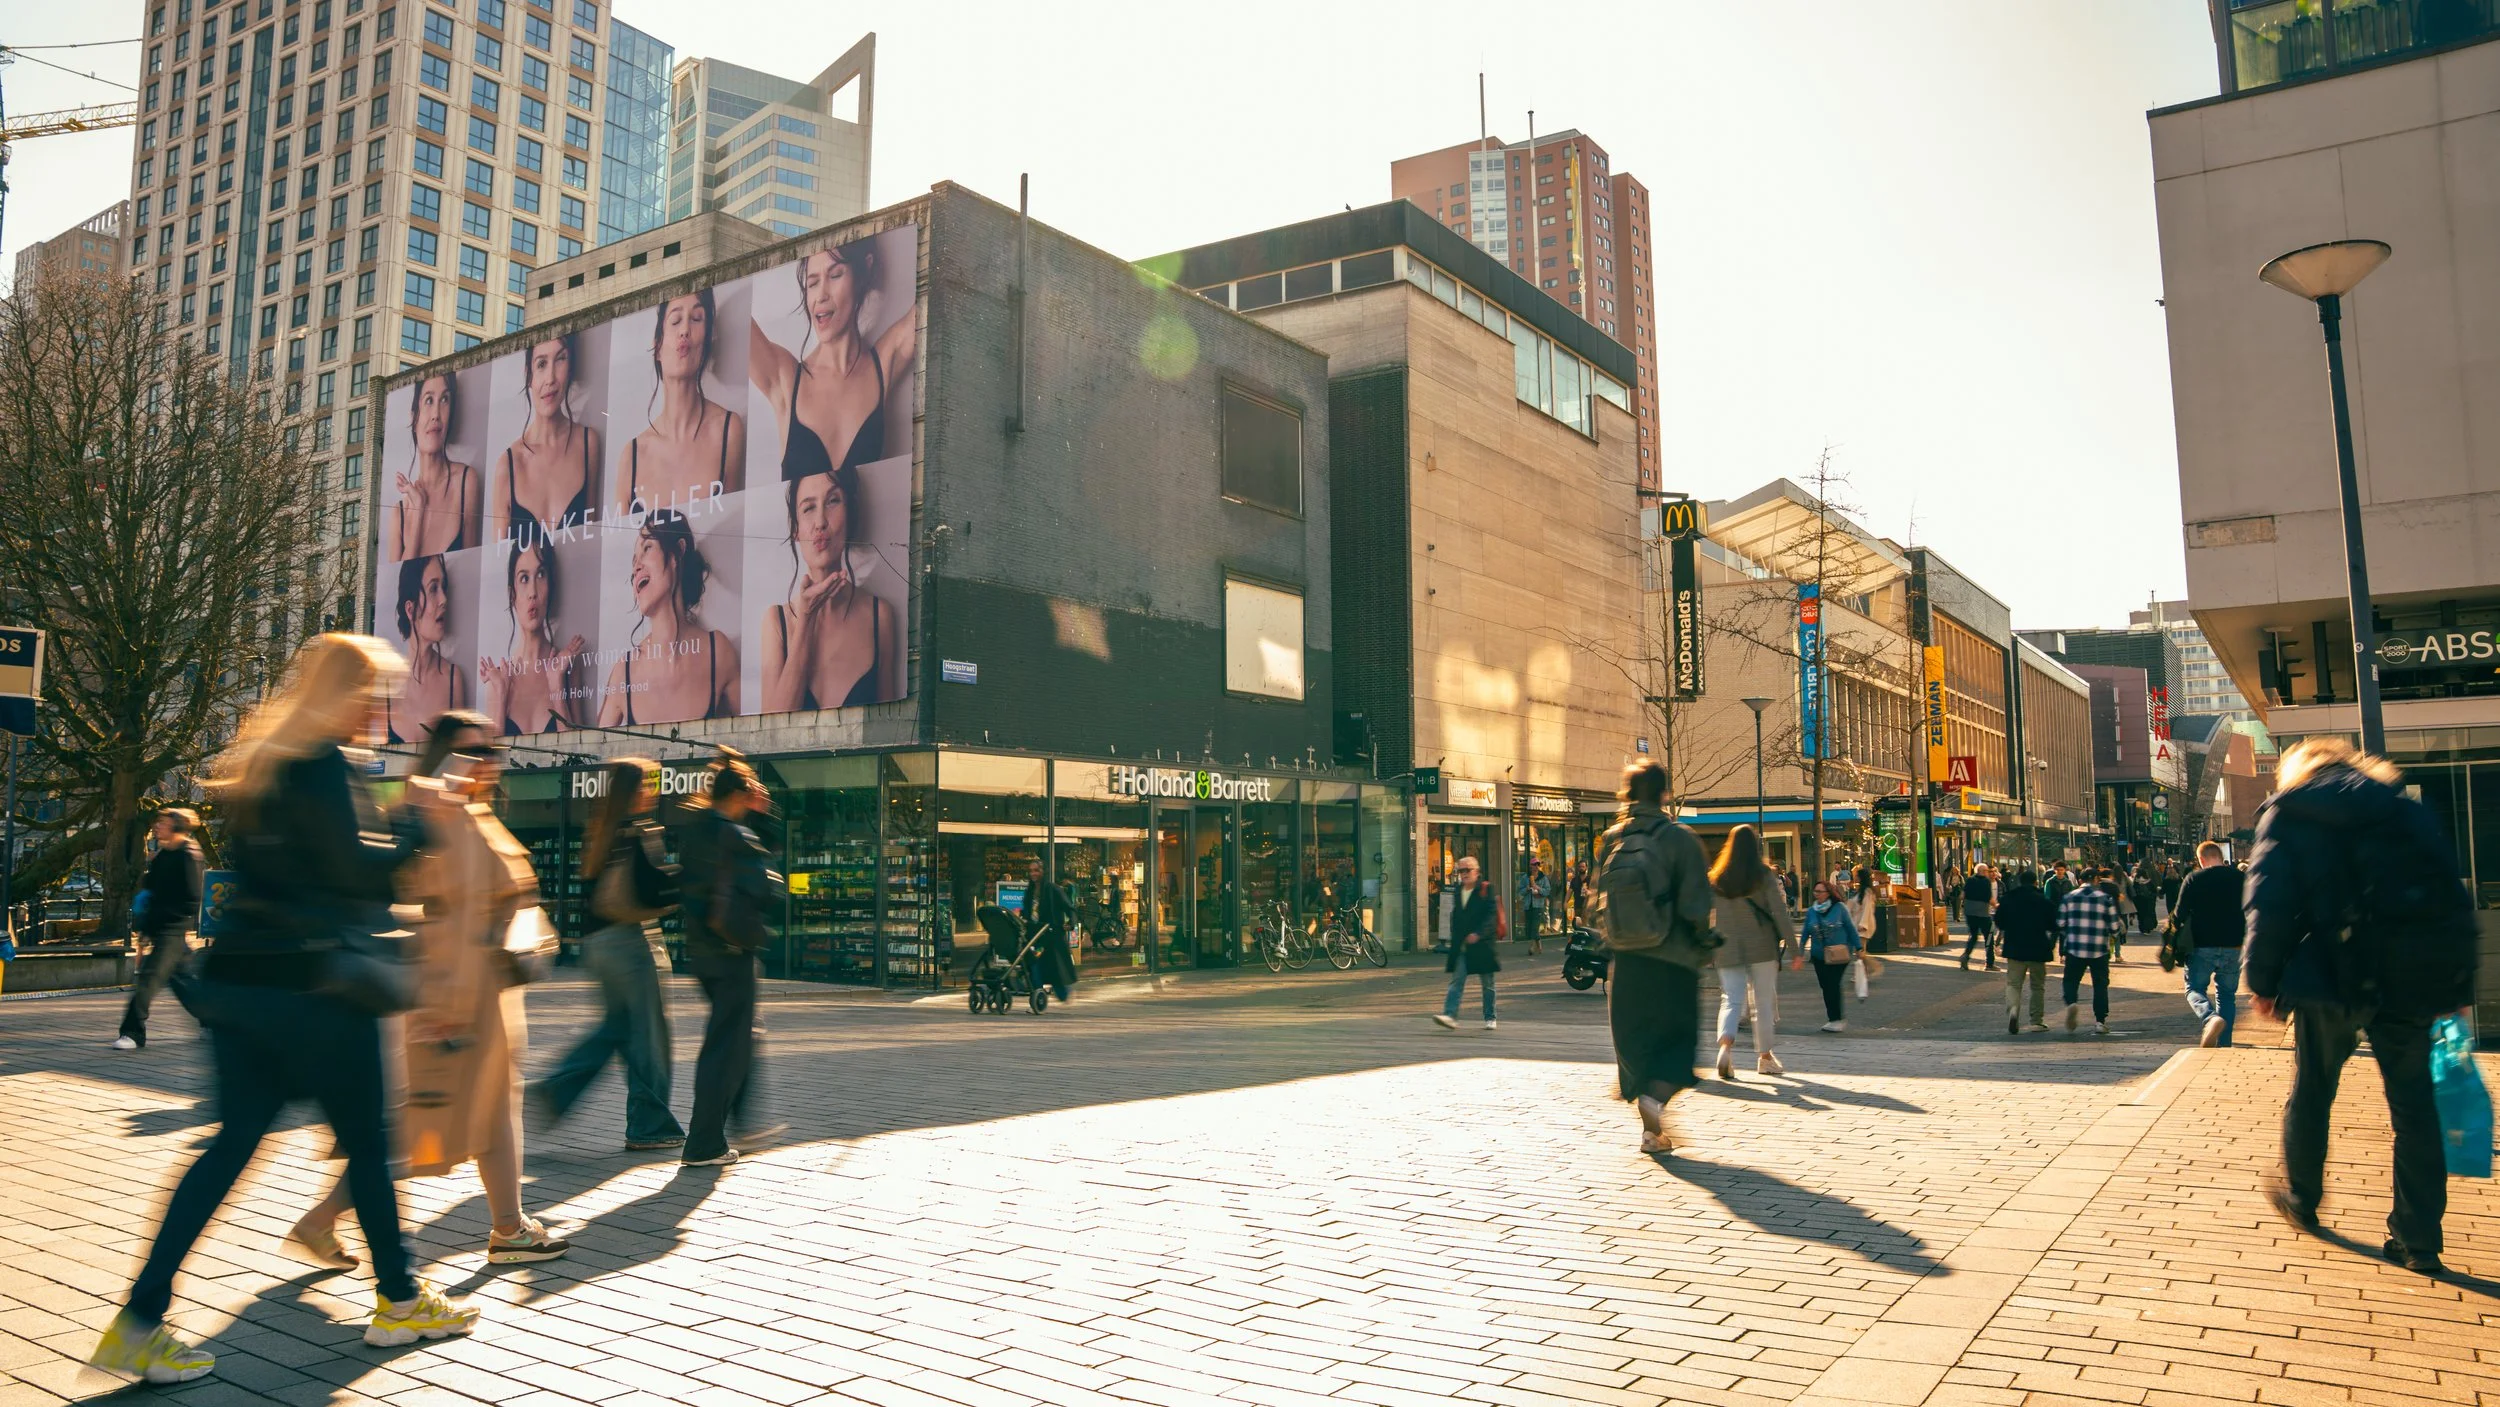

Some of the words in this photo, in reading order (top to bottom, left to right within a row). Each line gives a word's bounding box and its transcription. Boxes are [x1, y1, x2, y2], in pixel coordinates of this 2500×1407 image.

[496, 480, 724, 557] HUNKEMÖLLER
[508, 656, 529, 677] for
[534, 653, 577, 675] every
[582, 647, 640, 668] woman
[647, 638, 662, 660] in
[668, 638, 701, 663] you
[1678, 590, 1693, 690] McDonald's
[2383, 644, 2408, 652] SPORT
[549, 687, 568, 700] with
[570, 685, 594, 699] Holly
[620, 682, 648, 694] Brood
[2152, 685, 2171, 761] HEMA
[1531, 796, 1573, 813] McDonald's
